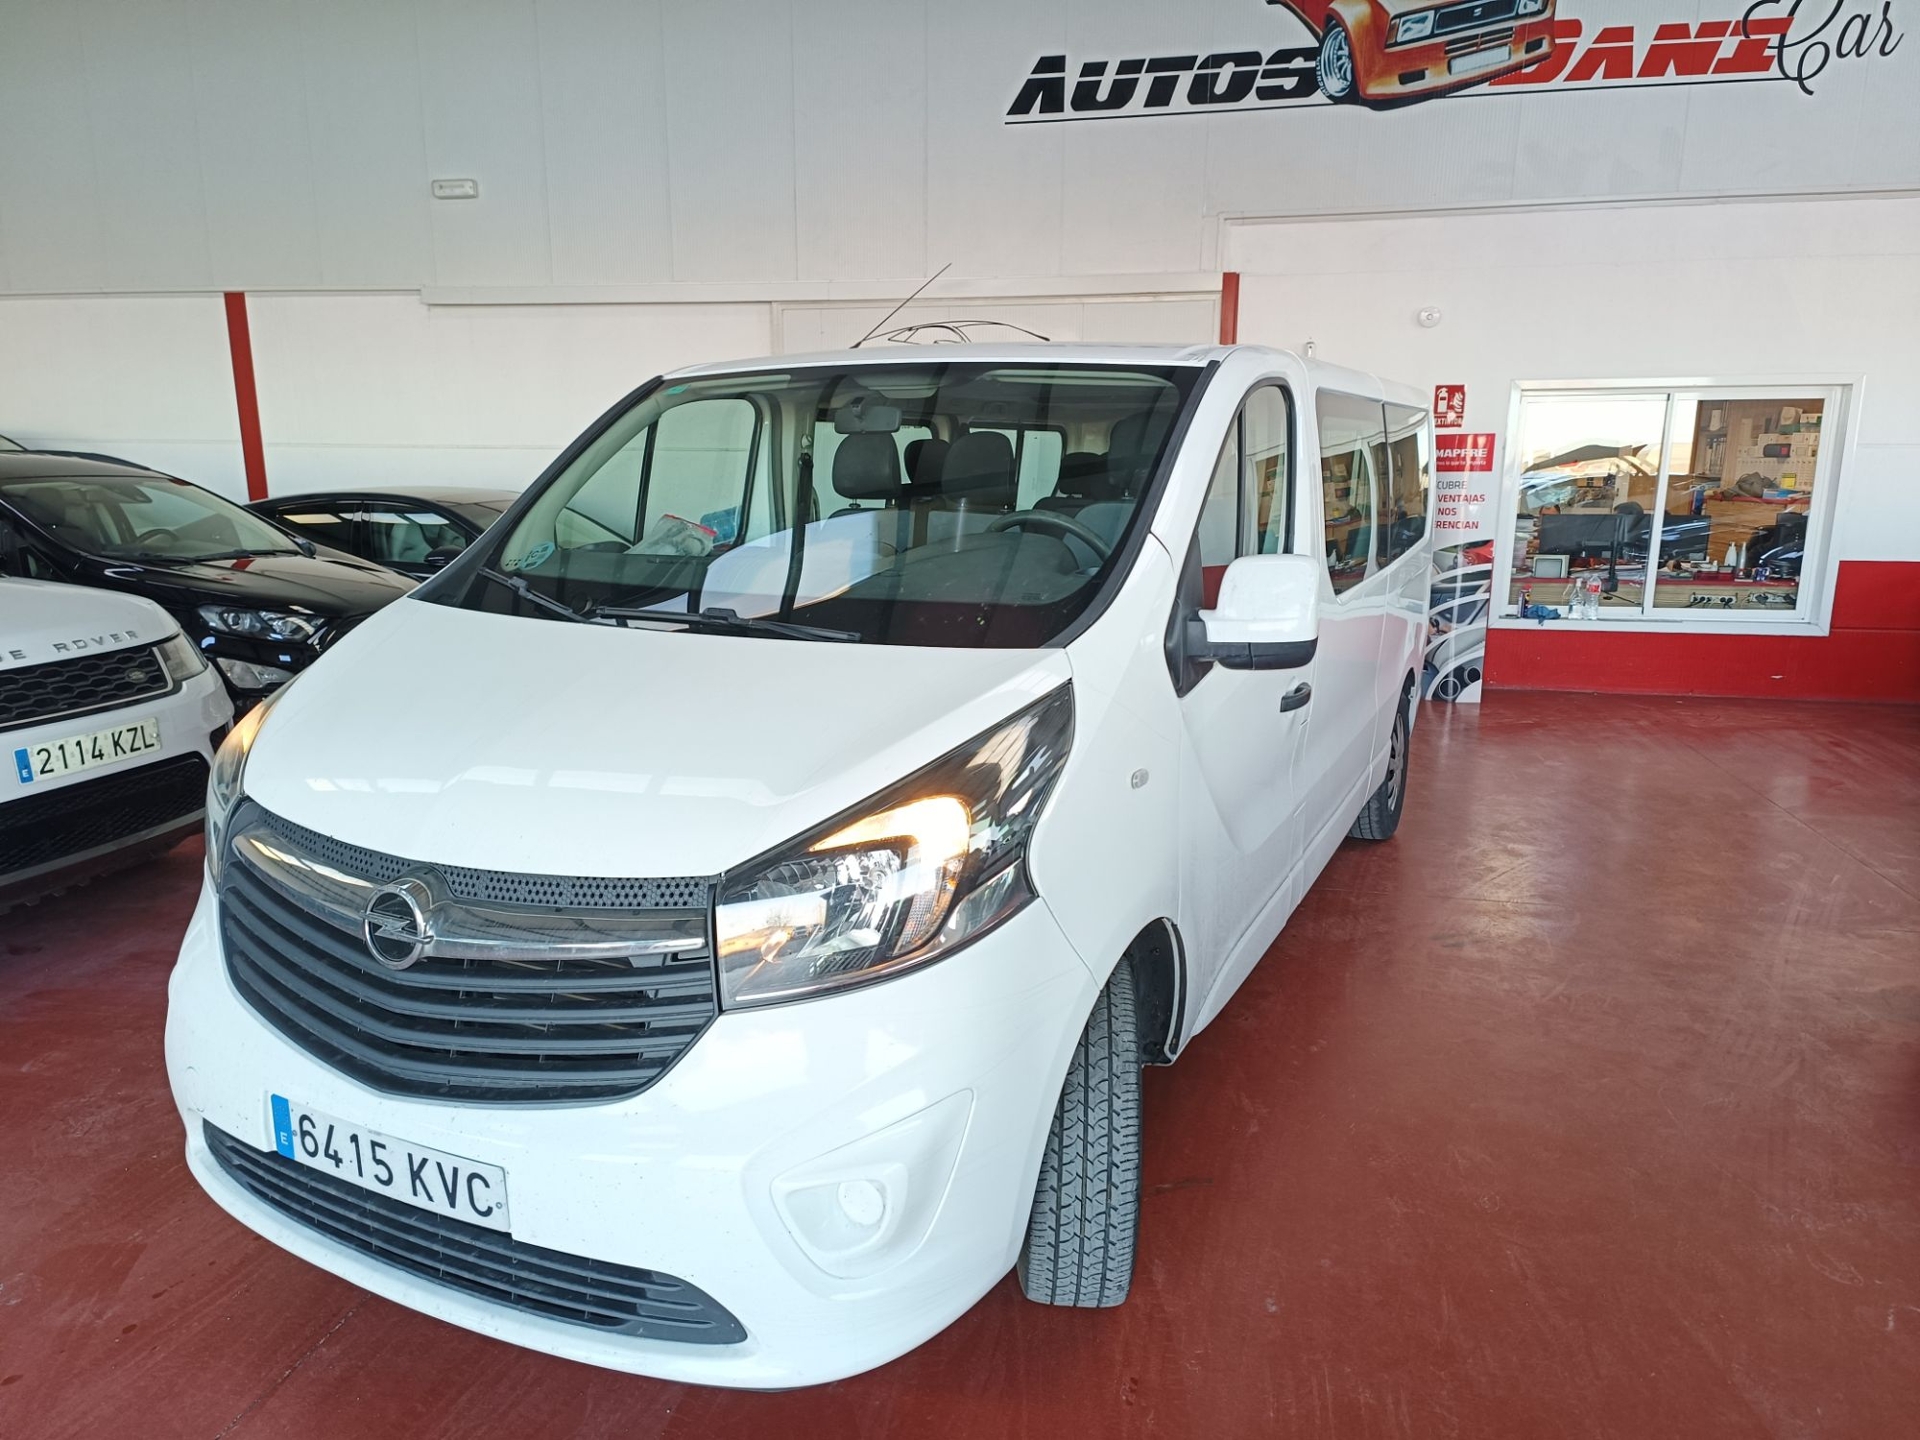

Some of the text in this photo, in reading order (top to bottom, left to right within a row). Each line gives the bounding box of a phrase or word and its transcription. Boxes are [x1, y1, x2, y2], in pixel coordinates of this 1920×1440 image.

[1006, 46, 1320, 115] AUTOS
[1742, 0, 1905, 95] Car
[1436, 448, 1488, 458] MAPFRE
[1437, 494, 1486, 505] VENTAJAS
[1437, 507, 1457, 516] NOS
[52, 630, 139, 653] ROVER
[36, 724, 155, 775] 2114 KZL
[21, 769, 30, 778] E
[280, 1131, 289, 1146] E
[298, 1114, 494, 1218] 6415 KVC
